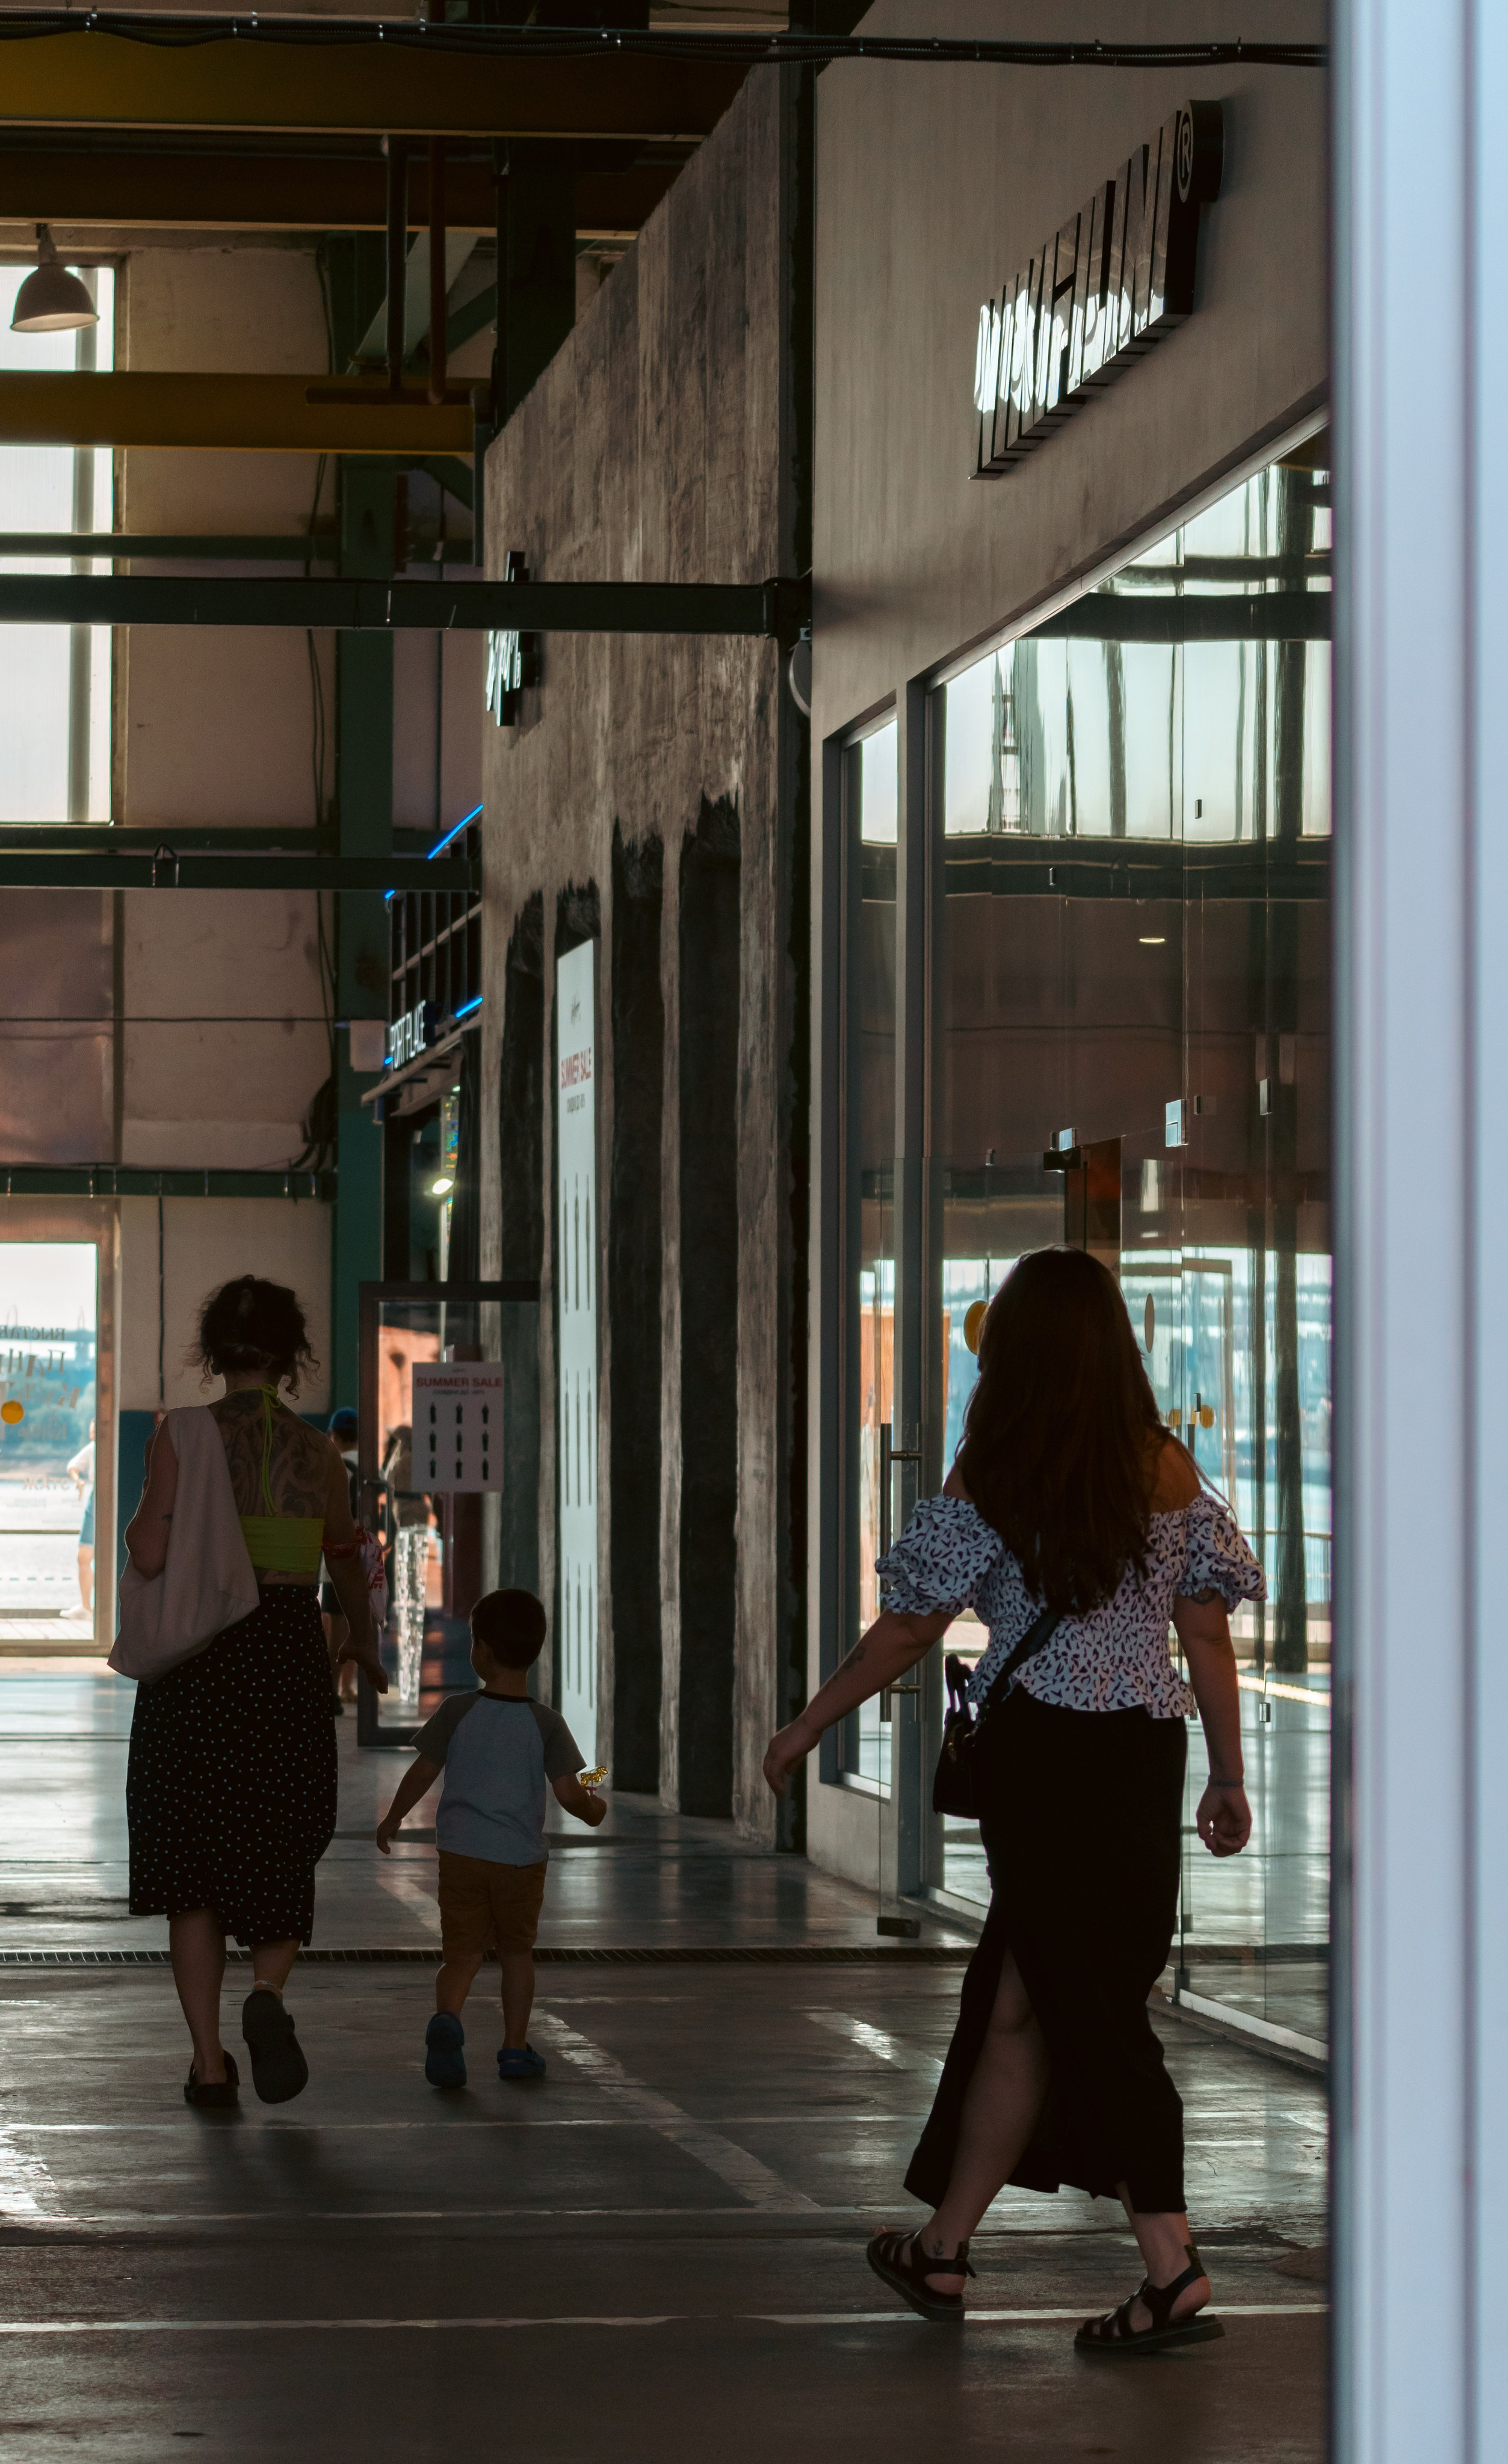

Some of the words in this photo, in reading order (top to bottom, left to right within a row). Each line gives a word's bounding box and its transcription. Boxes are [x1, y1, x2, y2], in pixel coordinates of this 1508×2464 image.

[561, 1053, 579, 1090] SUMMER
[580, 1047, 592, 1082] SALE
[416, 1377, 469, 1387] SUMMER
[472, 1376, 503, 1387] SALE
